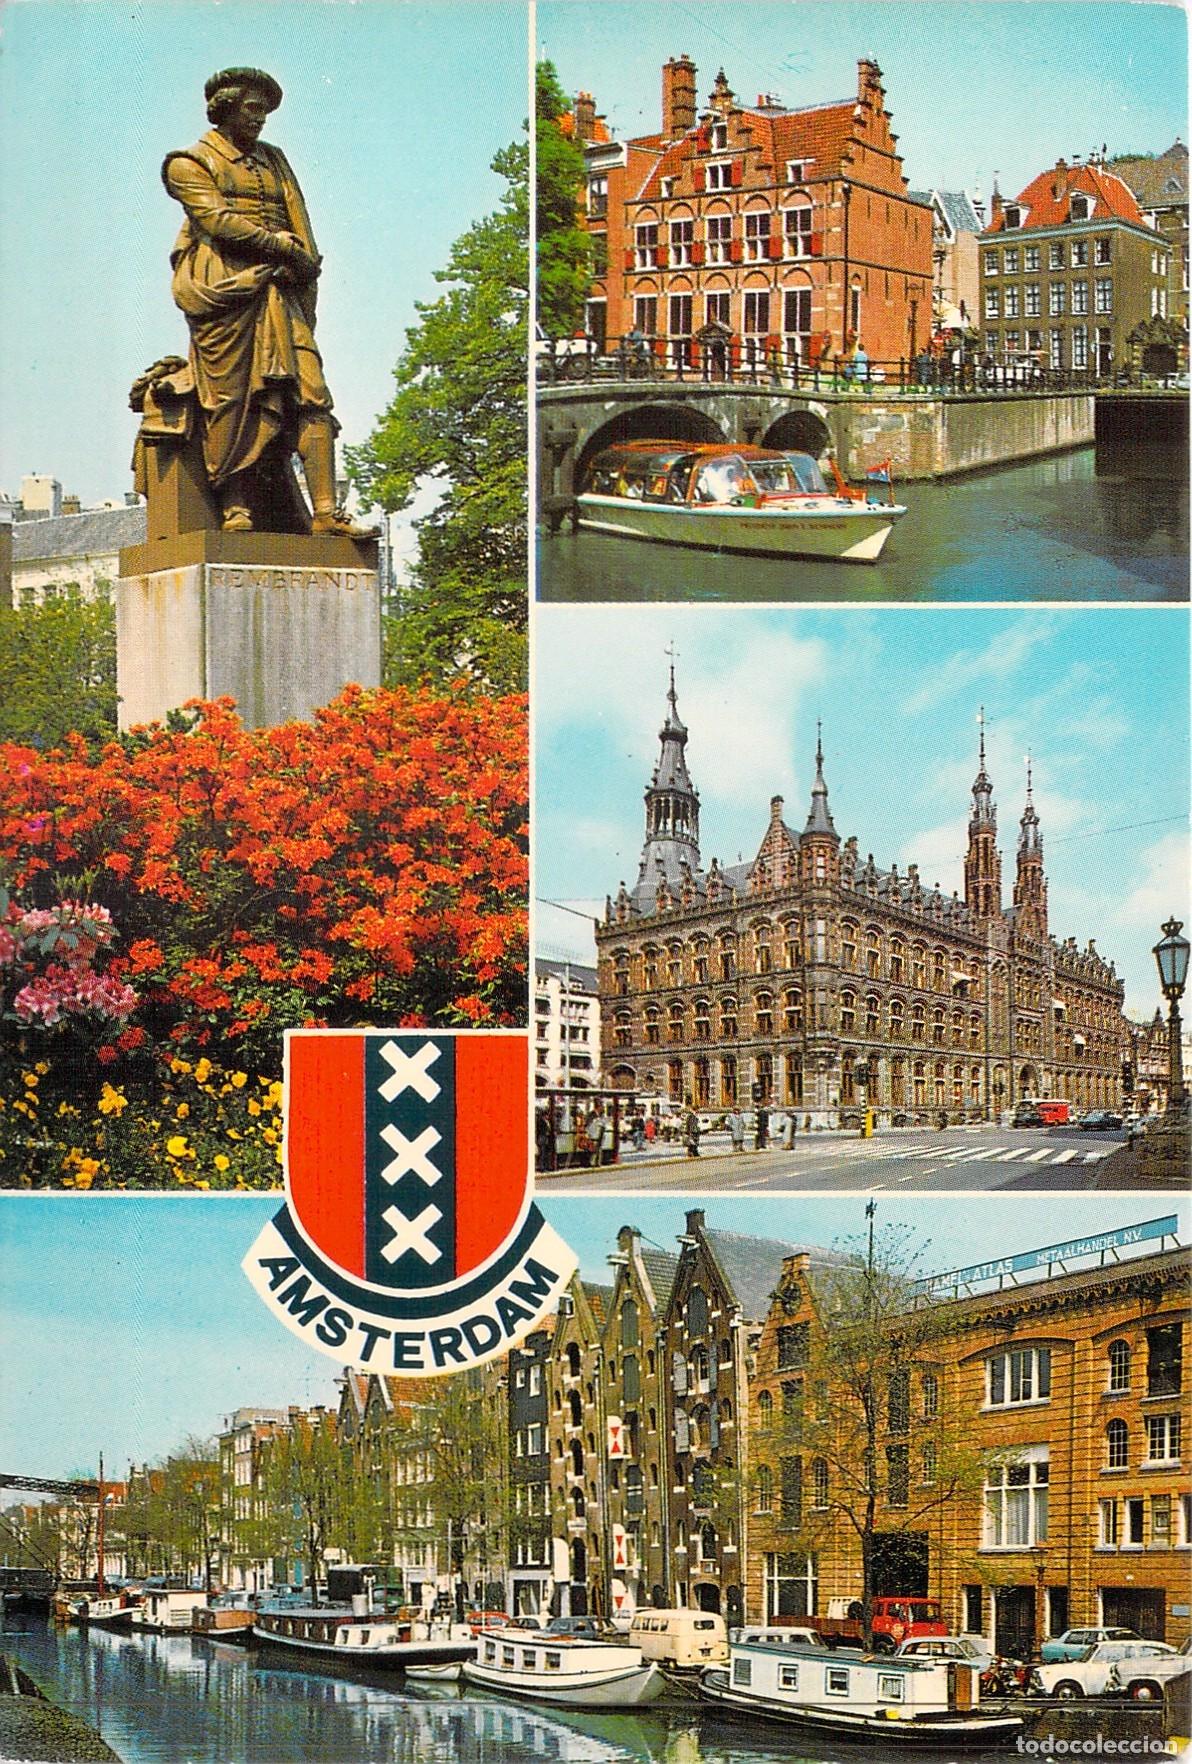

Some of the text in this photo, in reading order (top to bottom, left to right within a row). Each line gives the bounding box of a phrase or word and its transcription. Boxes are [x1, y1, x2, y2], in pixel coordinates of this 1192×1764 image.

[210, 568, 376, 591] REMBRANDT
[1036, 1236, 1119, 1265] METAALHANDEL
[259, 1256, 560, 1369] AMSTERDAM
